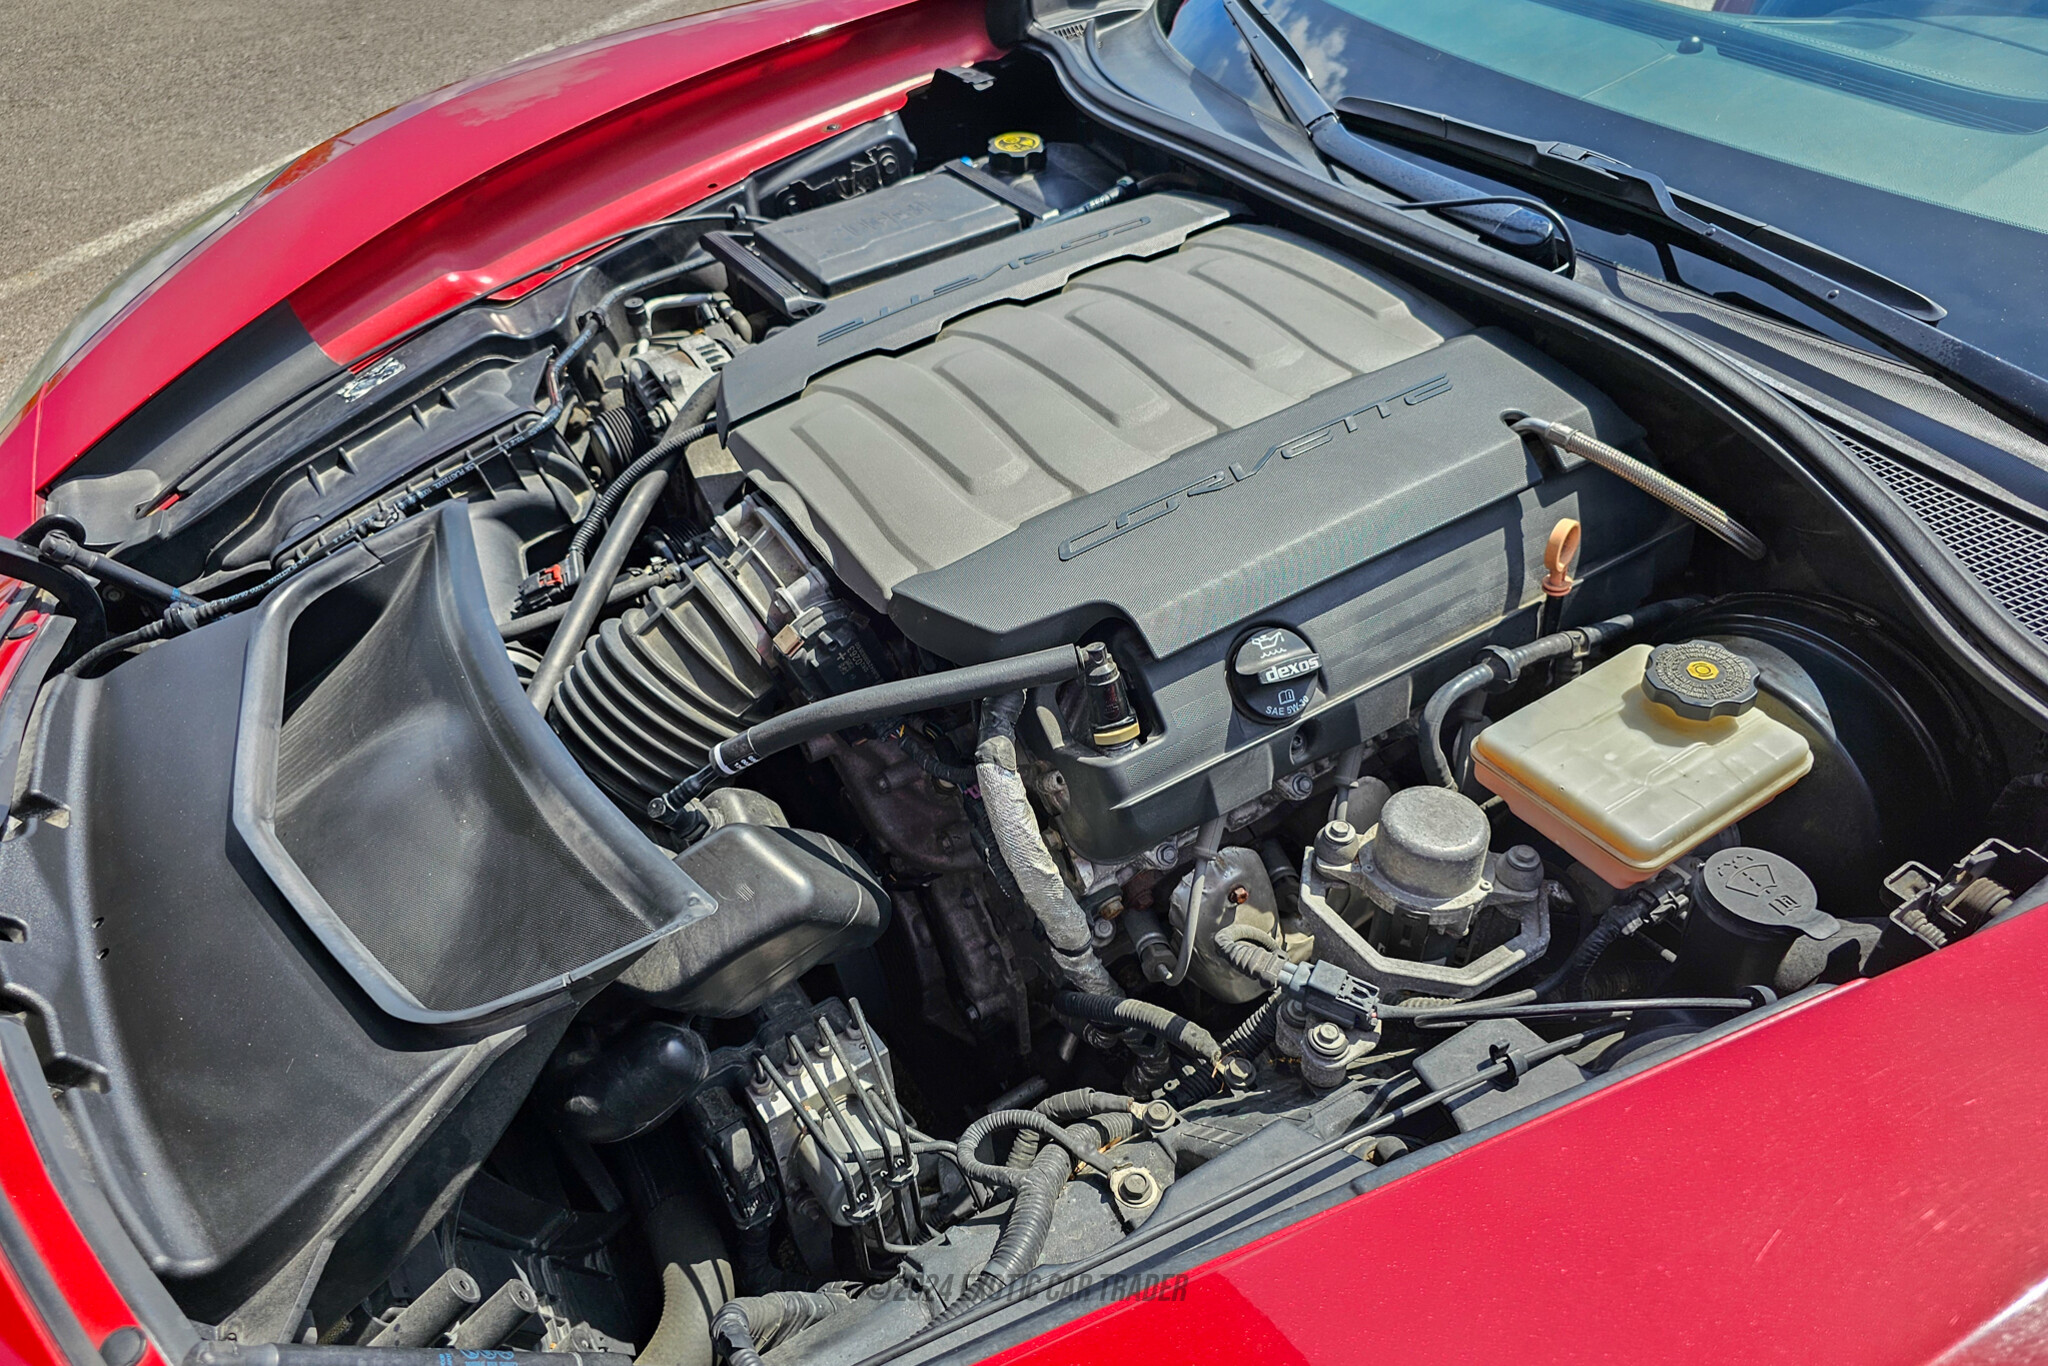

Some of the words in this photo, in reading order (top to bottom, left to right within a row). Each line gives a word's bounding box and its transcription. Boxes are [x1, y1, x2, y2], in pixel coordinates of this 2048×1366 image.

[817, 216, 1152, 346] CORVETTE
[1059, 372, 1453, 561] CORVETTE
[1265, 656, 1319, 682] dexos
[1265, 705, 1285, 715] SAE
[1287, 695, 1309, 714] 5W-30
